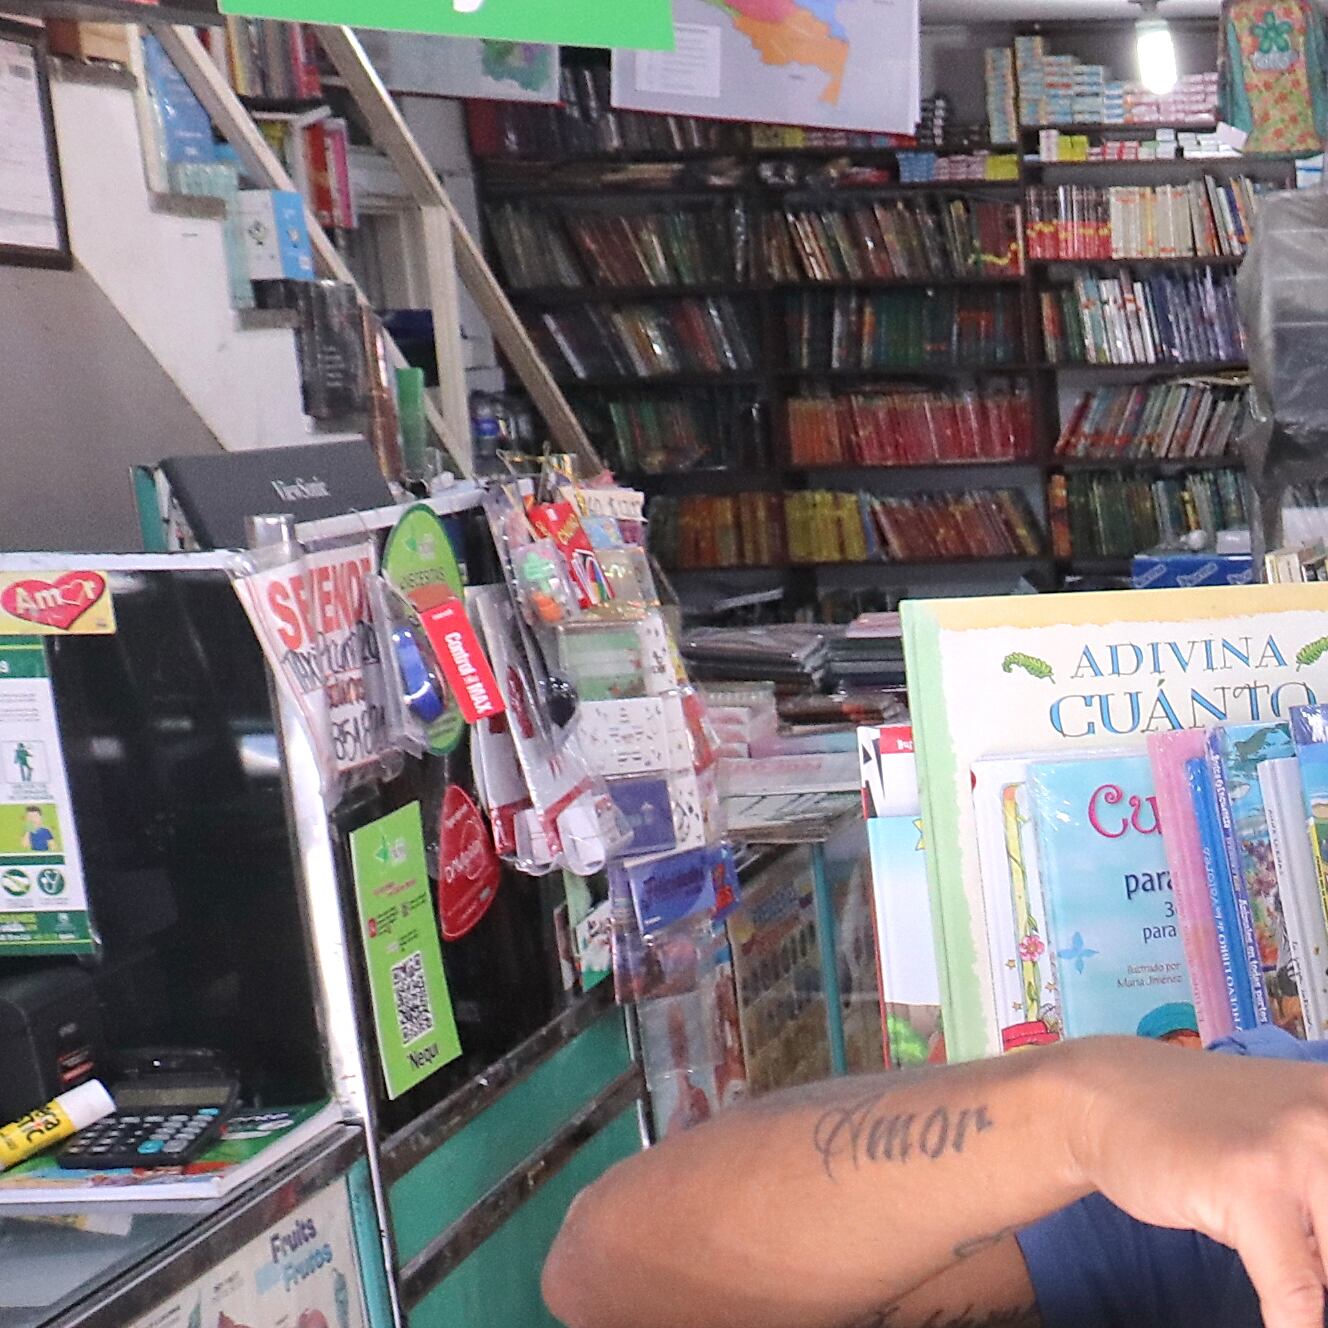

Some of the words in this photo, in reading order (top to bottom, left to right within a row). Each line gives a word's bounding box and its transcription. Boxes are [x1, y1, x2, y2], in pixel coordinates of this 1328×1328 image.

[1070, 634, 1288, 680] ADIVINA
[1050, 679, 1317, 738] CUÁNTO
[407, 1042, 440, 1070] Nequi
